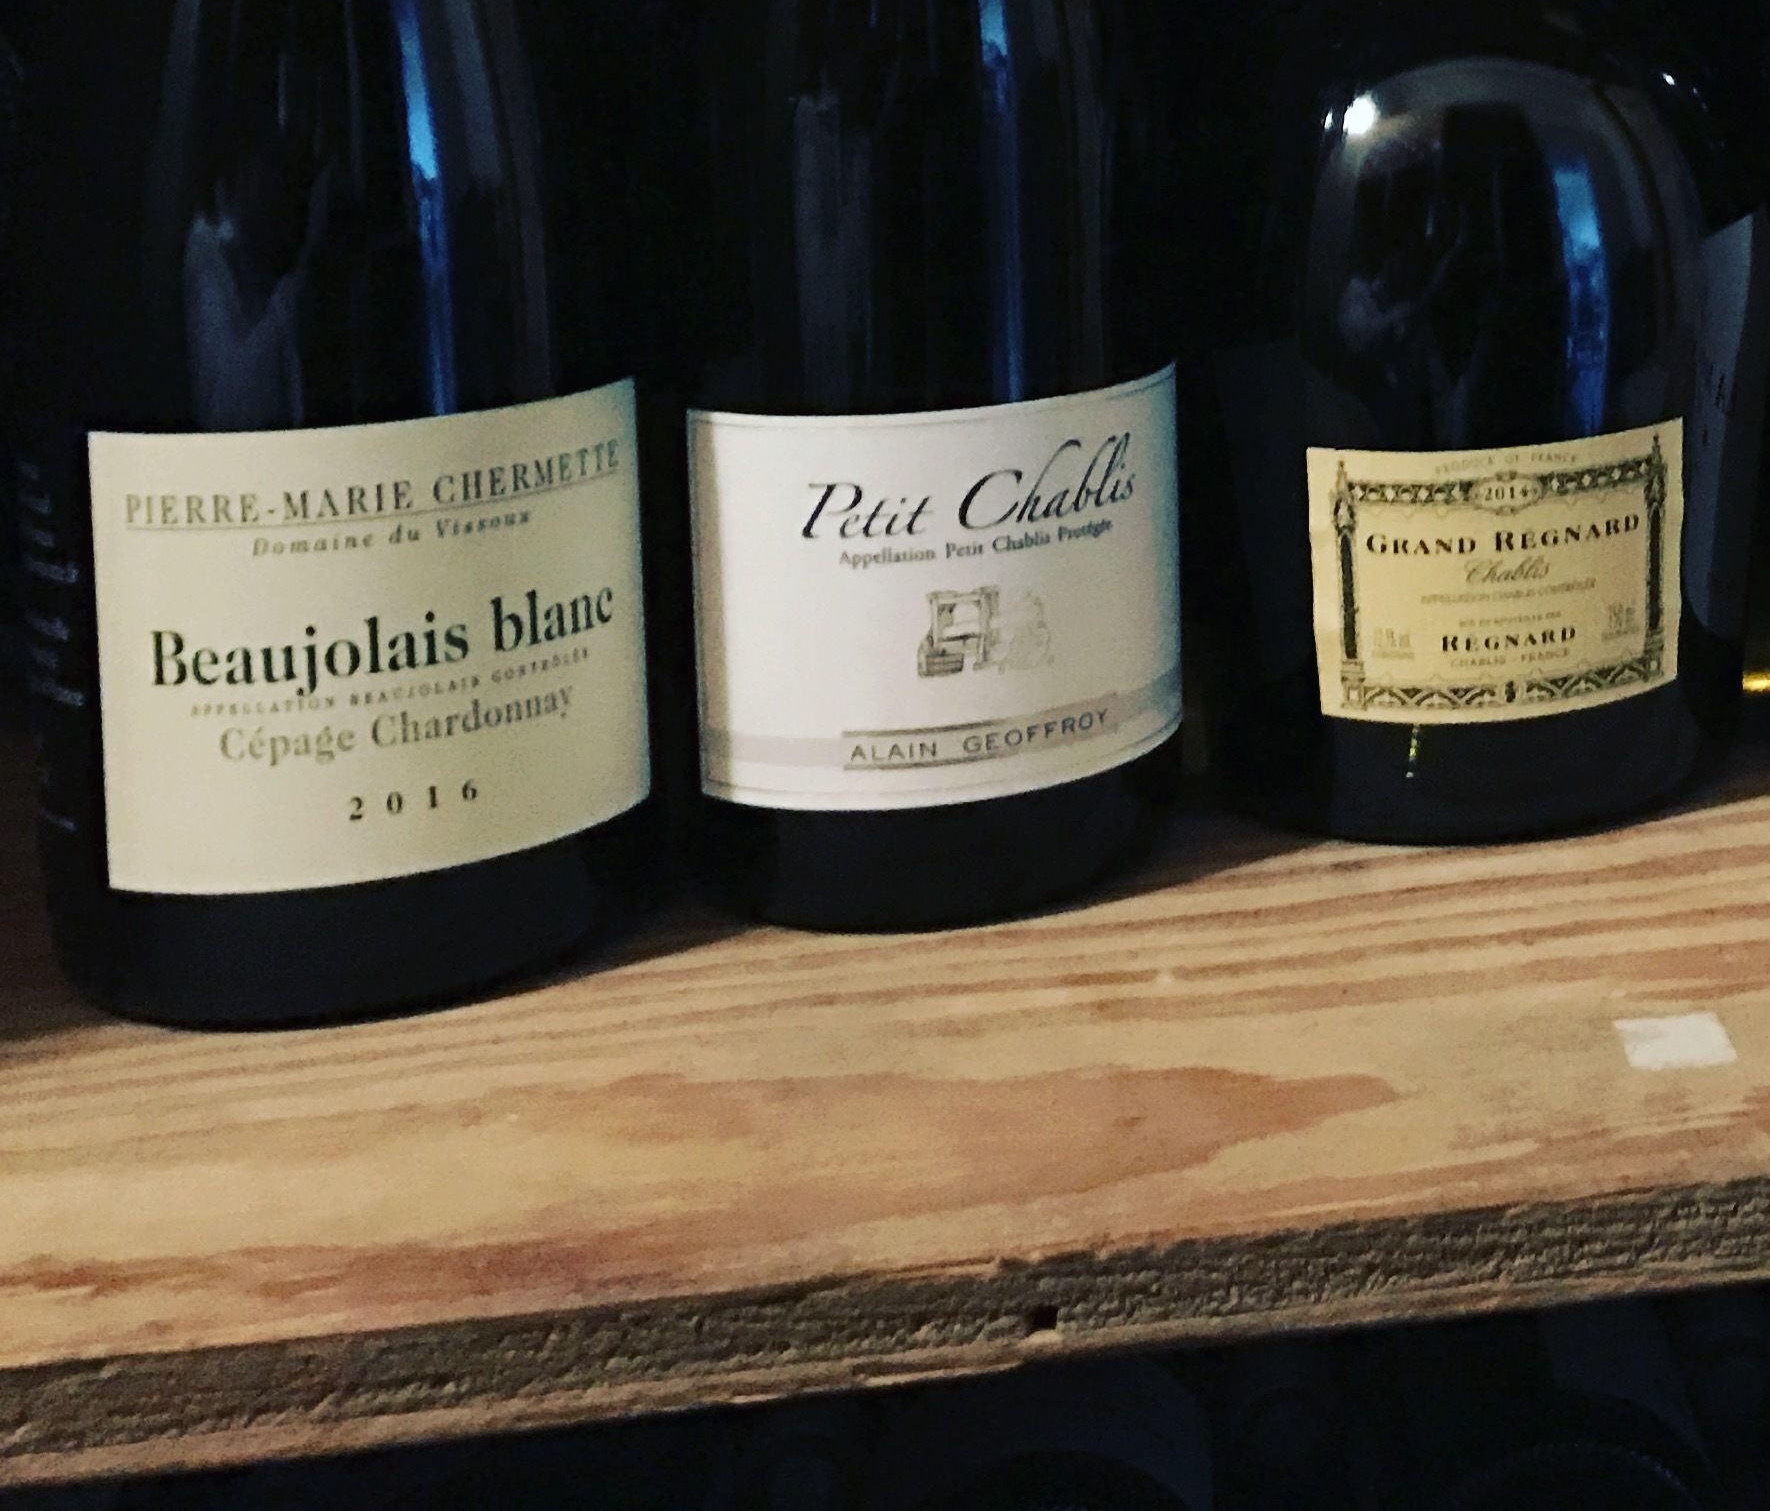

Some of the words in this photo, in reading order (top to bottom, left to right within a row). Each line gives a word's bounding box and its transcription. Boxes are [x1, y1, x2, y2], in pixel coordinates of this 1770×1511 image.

[124, 480, 412, 524] PIERRE-MARIE
[432, 438, 620, 506] CHERMETTE
[801, 480, 935, 540] Petit
[958, 431, 1137, 531] Chablis
[252, 530, 374, 557] Domaine
[389, 521, 421, 545] du
[436, 510, 531, 539] Vissoux
[838, 548, 936, 571] Appellation
[945, 541, 984, 560] Petit
[992, 531, 1050, 554] Chablis
[1366, 532, 1477, 556] GRAND
[1463, 554, 1553, 585] Chablis
[151, 611, 470, 697] Beaujolais
[490, 586, 614, 653] blanc
[350, 675, 481, 706] BEAUJOLAIS
[220, 724, 357, 767] Cépage
[371, 684, 574, 750] Chardonnay
[850, 741, 938, 762] ALAIN
[962, 707, 1109, 755] GEOFFROY
